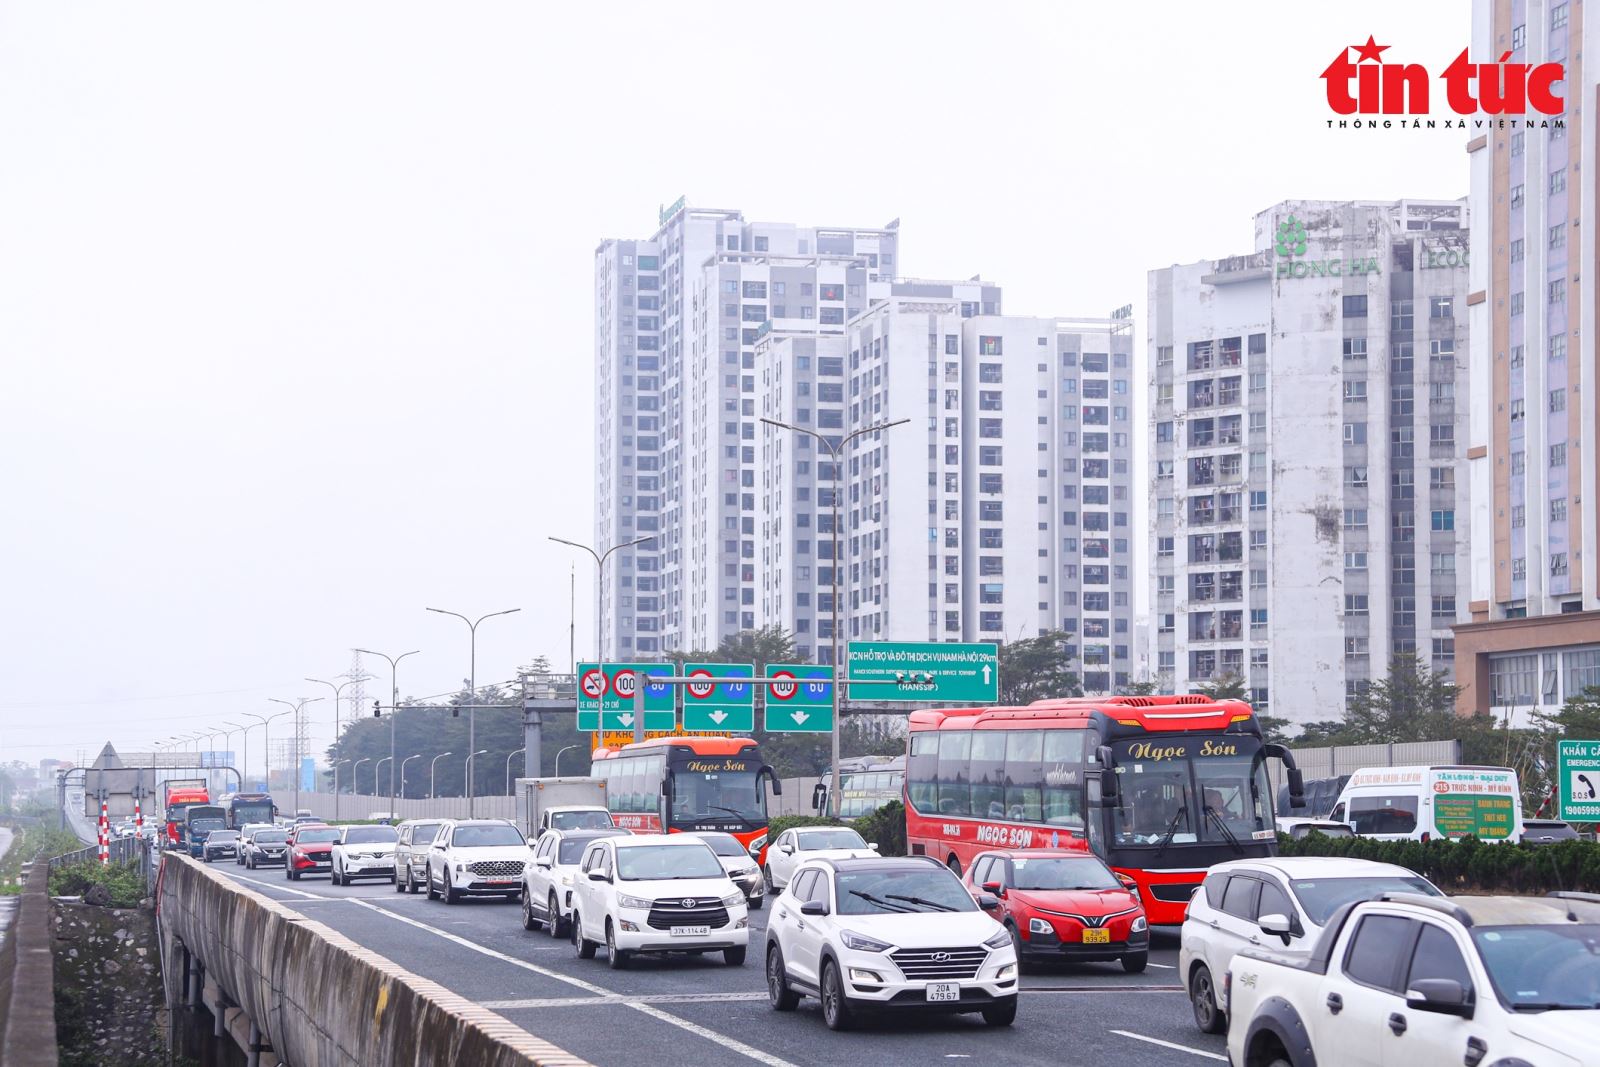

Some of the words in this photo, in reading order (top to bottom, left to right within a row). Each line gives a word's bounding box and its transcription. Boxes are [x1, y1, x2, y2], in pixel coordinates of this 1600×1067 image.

[775, 682, 792, 692] 100
[1128, 742, 1186, 762] Ngọc
[1200, 740, 1238, 757] Sơn
[1562, 743, 1587, 756] KHẨN
[687, 760, 721, 773] Ngọc
[723, 759, 746, 771] Sơn
[1435, 782, 1449, 792] 215
[976, 825, 1009, 846] NGỌC
[1009, 827, 1033, 848] SƠN
[936, 984, 950, 992] 20A
[930, 992, 957, 1000] 479.67
